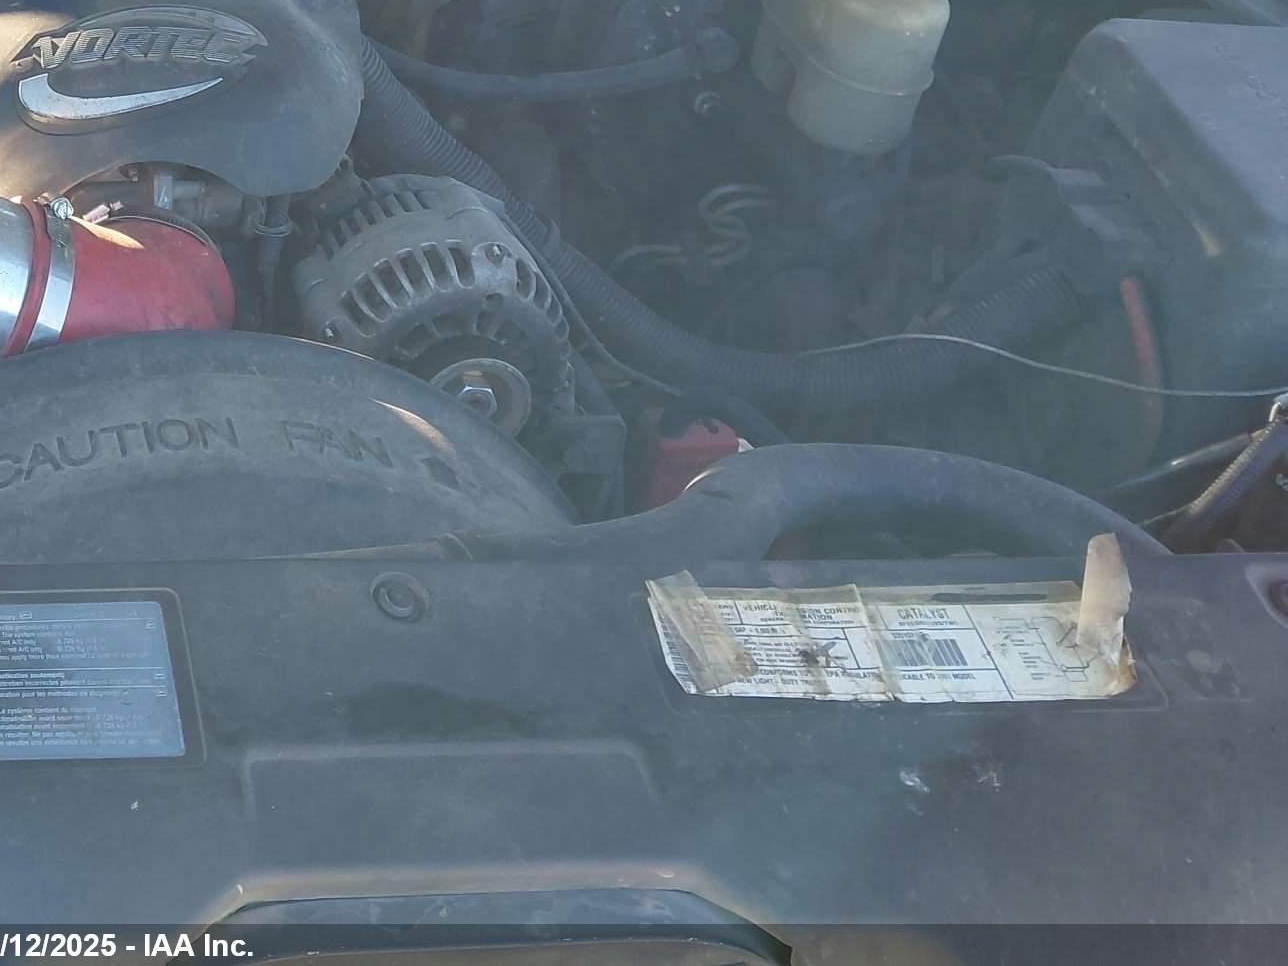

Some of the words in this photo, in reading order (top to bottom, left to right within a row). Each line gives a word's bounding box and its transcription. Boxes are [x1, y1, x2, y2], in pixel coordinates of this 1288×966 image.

[32, 25, 246, 70] VORTEC
[279, 419, 394, 469] FAN
[897, 608, 950, 619] CATALYST
